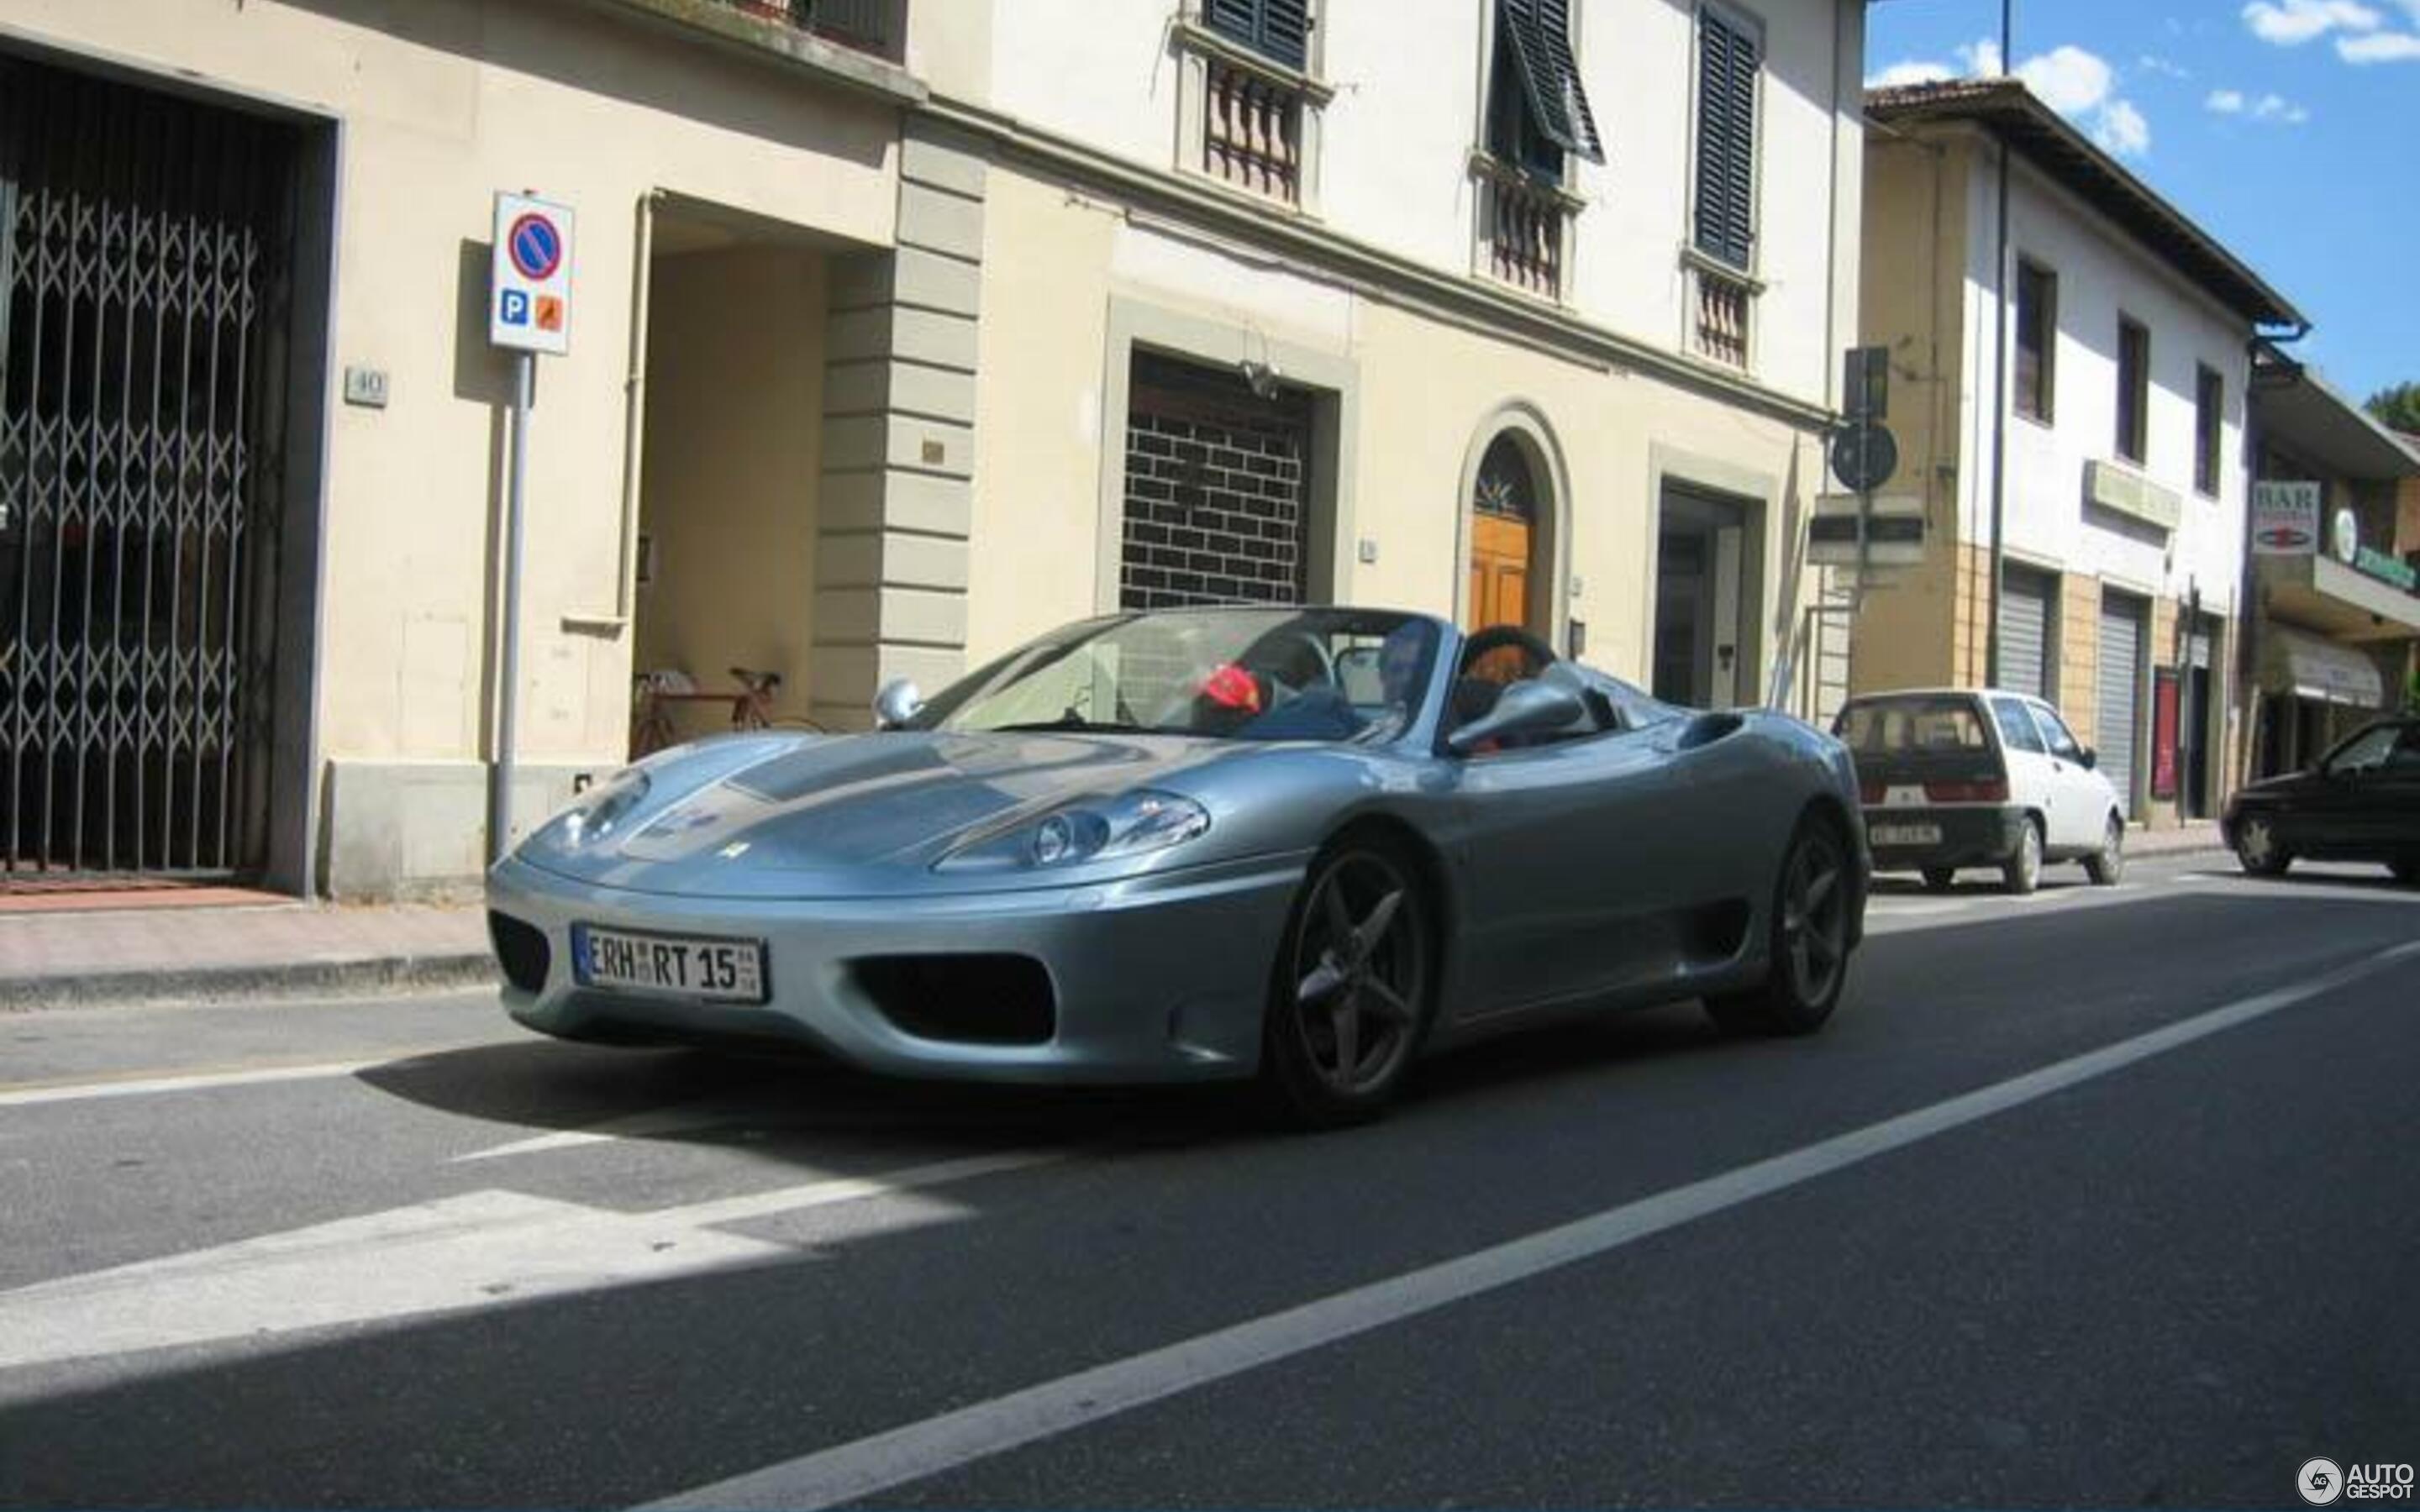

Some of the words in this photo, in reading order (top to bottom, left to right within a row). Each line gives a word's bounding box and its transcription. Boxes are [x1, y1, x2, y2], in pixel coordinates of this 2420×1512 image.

[508, 295, 523, 321] P
[2256, 486, 2312, 509] BAR
[590, 937, 635, 980] ERH
[653, 944, 687, 986] RT
[697, 948, 736, 989] 15
